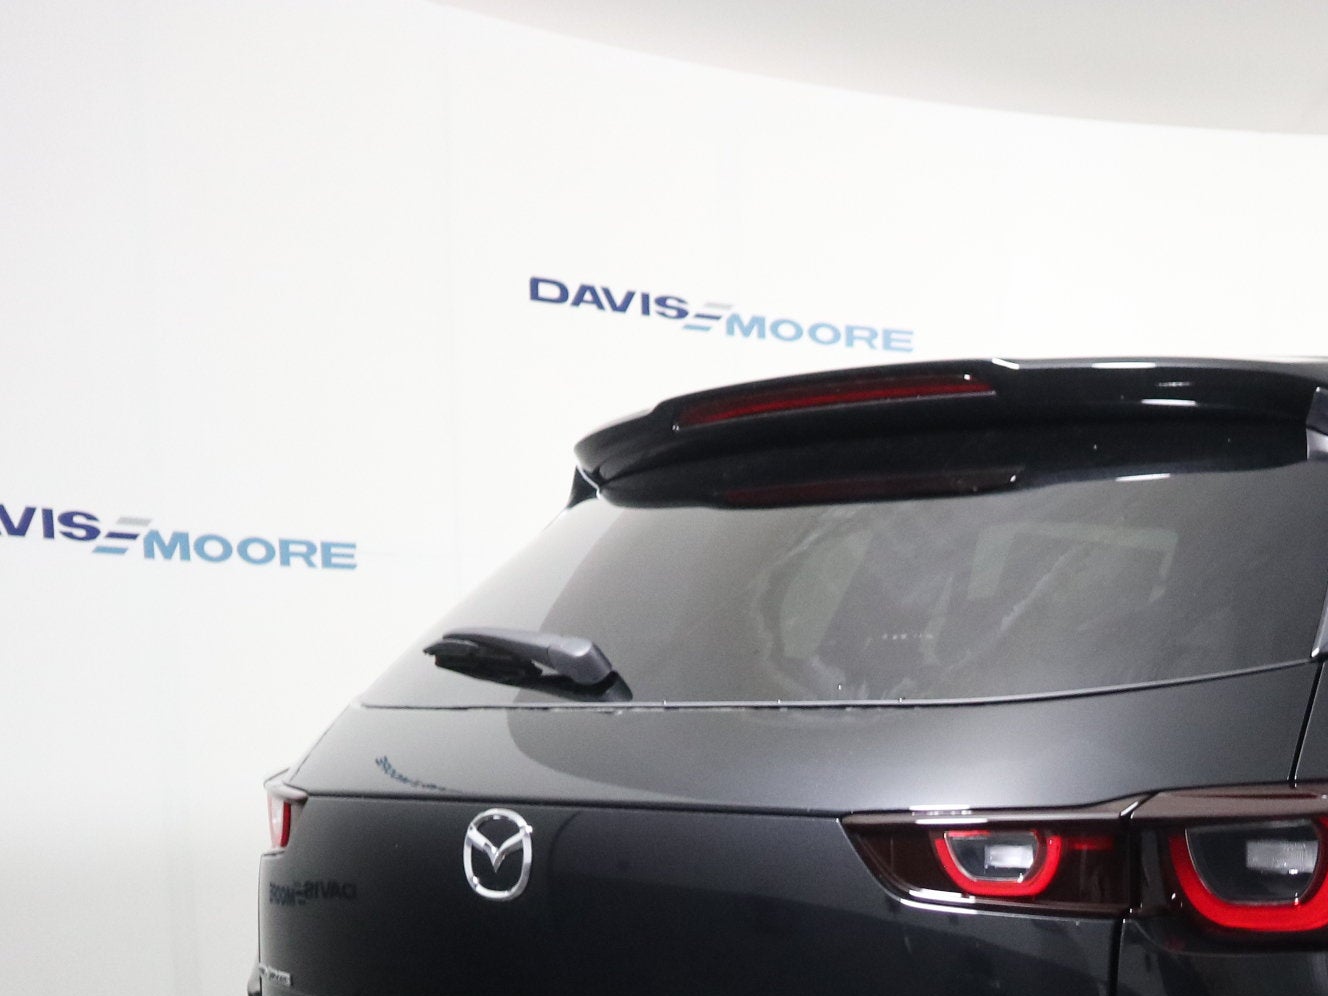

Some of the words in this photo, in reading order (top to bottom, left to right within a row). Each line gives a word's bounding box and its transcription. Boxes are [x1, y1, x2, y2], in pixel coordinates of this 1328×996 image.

[529, 276, 689, 321] DAVIS
[725, 312, 914, 353] MOORE
[0, 503, 101, 542] VIS
[142, 529, 358, 571] MOORE
